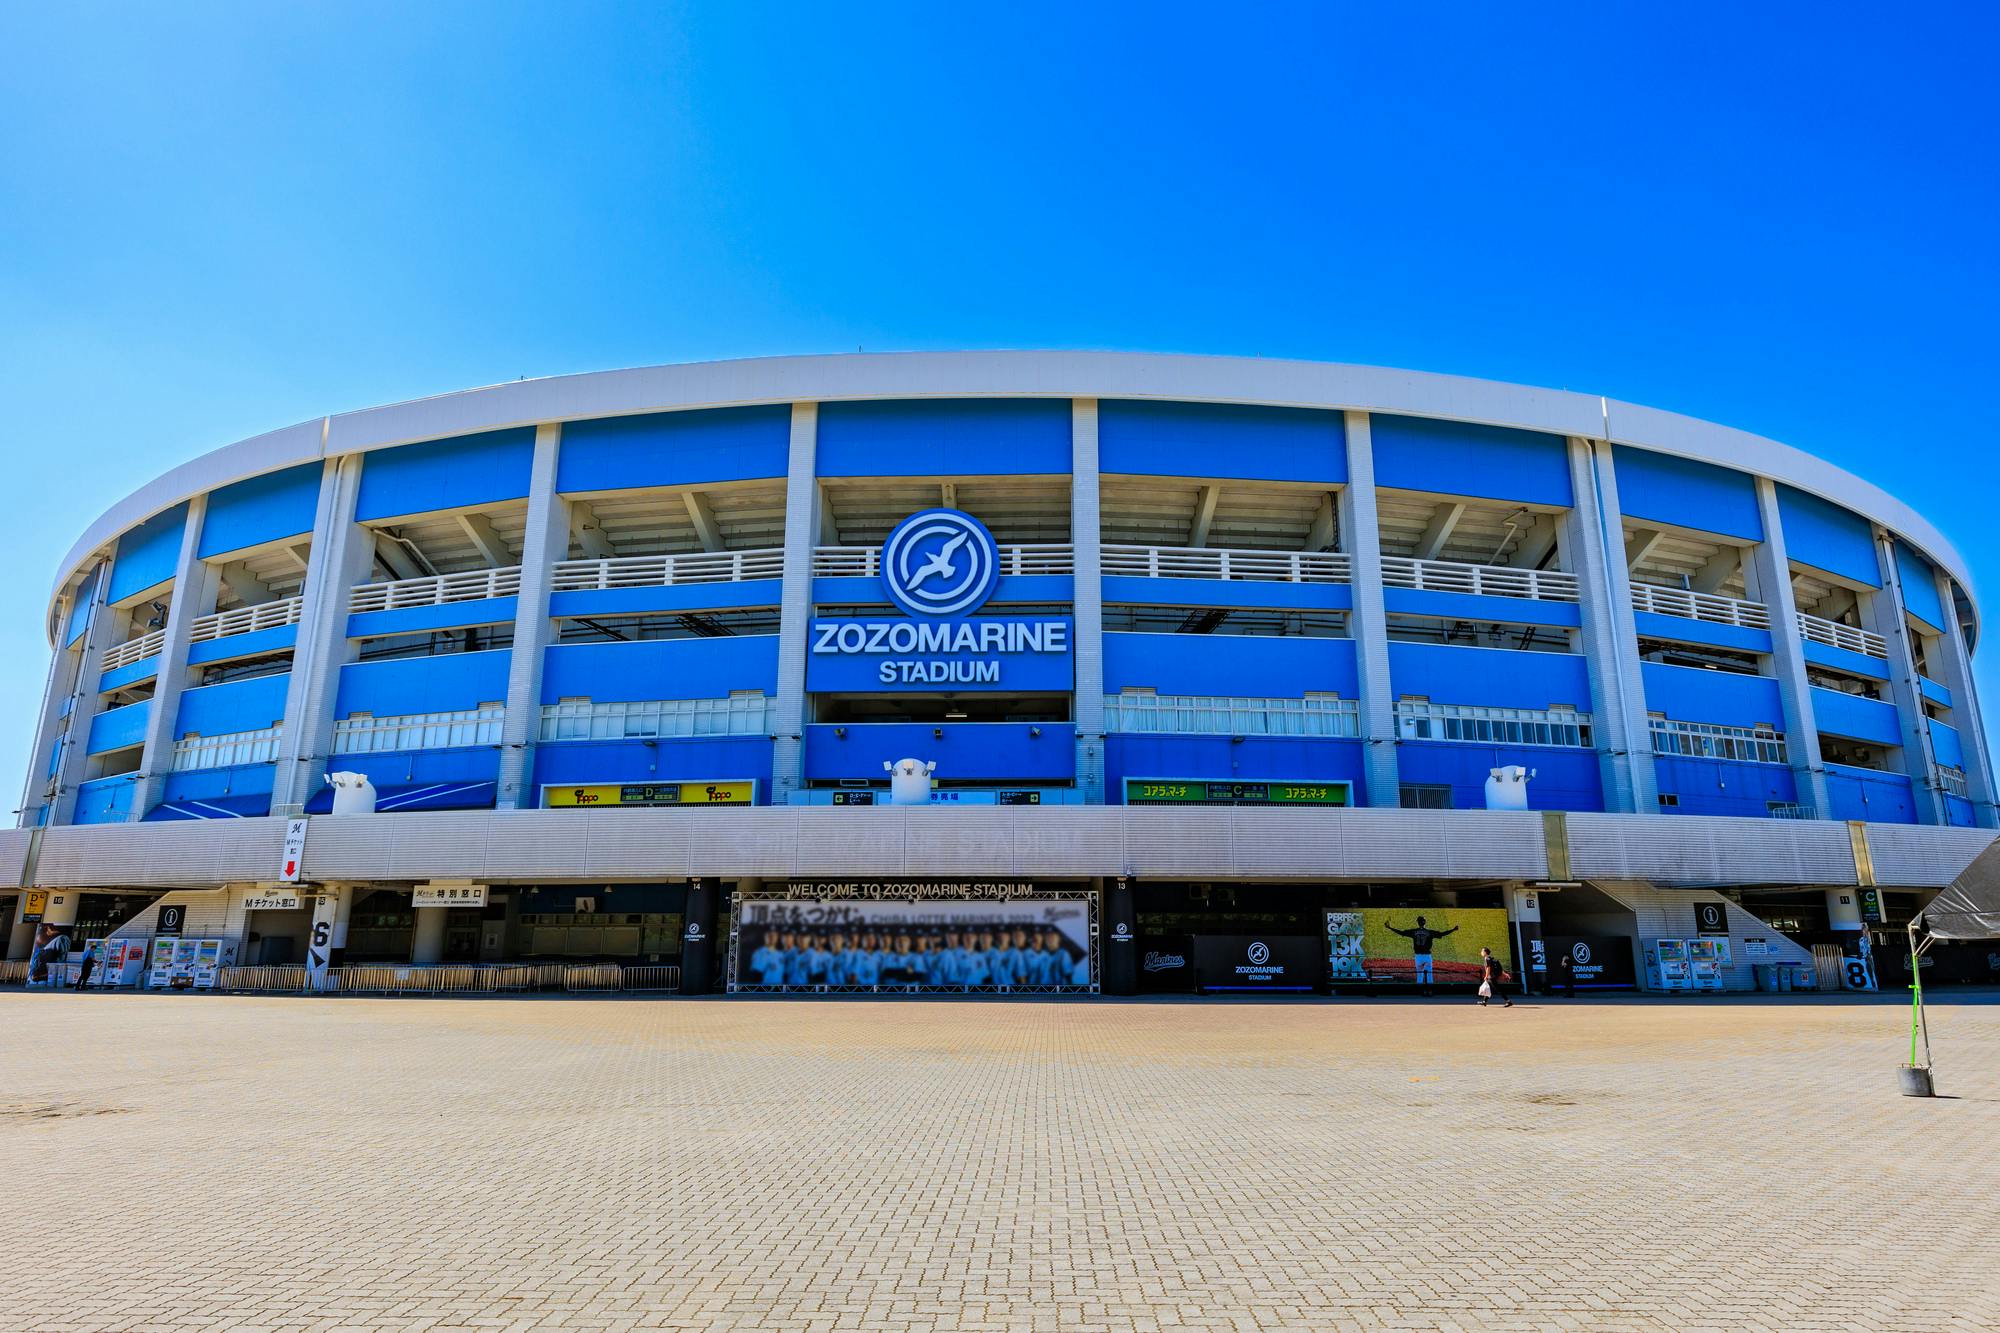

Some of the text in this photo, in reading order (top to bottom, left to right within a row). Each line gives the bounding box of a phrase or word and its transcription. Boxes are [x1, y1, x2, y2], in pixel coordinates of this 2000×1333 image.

[813, 622, 1067, 653] ZOZOMARINE
[879, 660, 1000, 683] STADIUM
[645, 787, 654, 797] D
[1233, 784, 1242, 795] C
[788, 884, 1033, 896] WELCOME TO ZOZOMARINE STADIUM
[1118, 882, 1126, 890] 13
[1865, 891, 1876, 902] C
[1327, 912, 1364, 922] PERFECT
[314, 921, 330, 947] 6
[1328, 935, 1365, 956] 13K
[1235, 965, 1284, 974] ZOZOMARINE
[1329, 956, 1368, 977] 19K
[1572, 965, 1604, 973] ZOMARINE
[1847, 962, 1867, 988] 8
